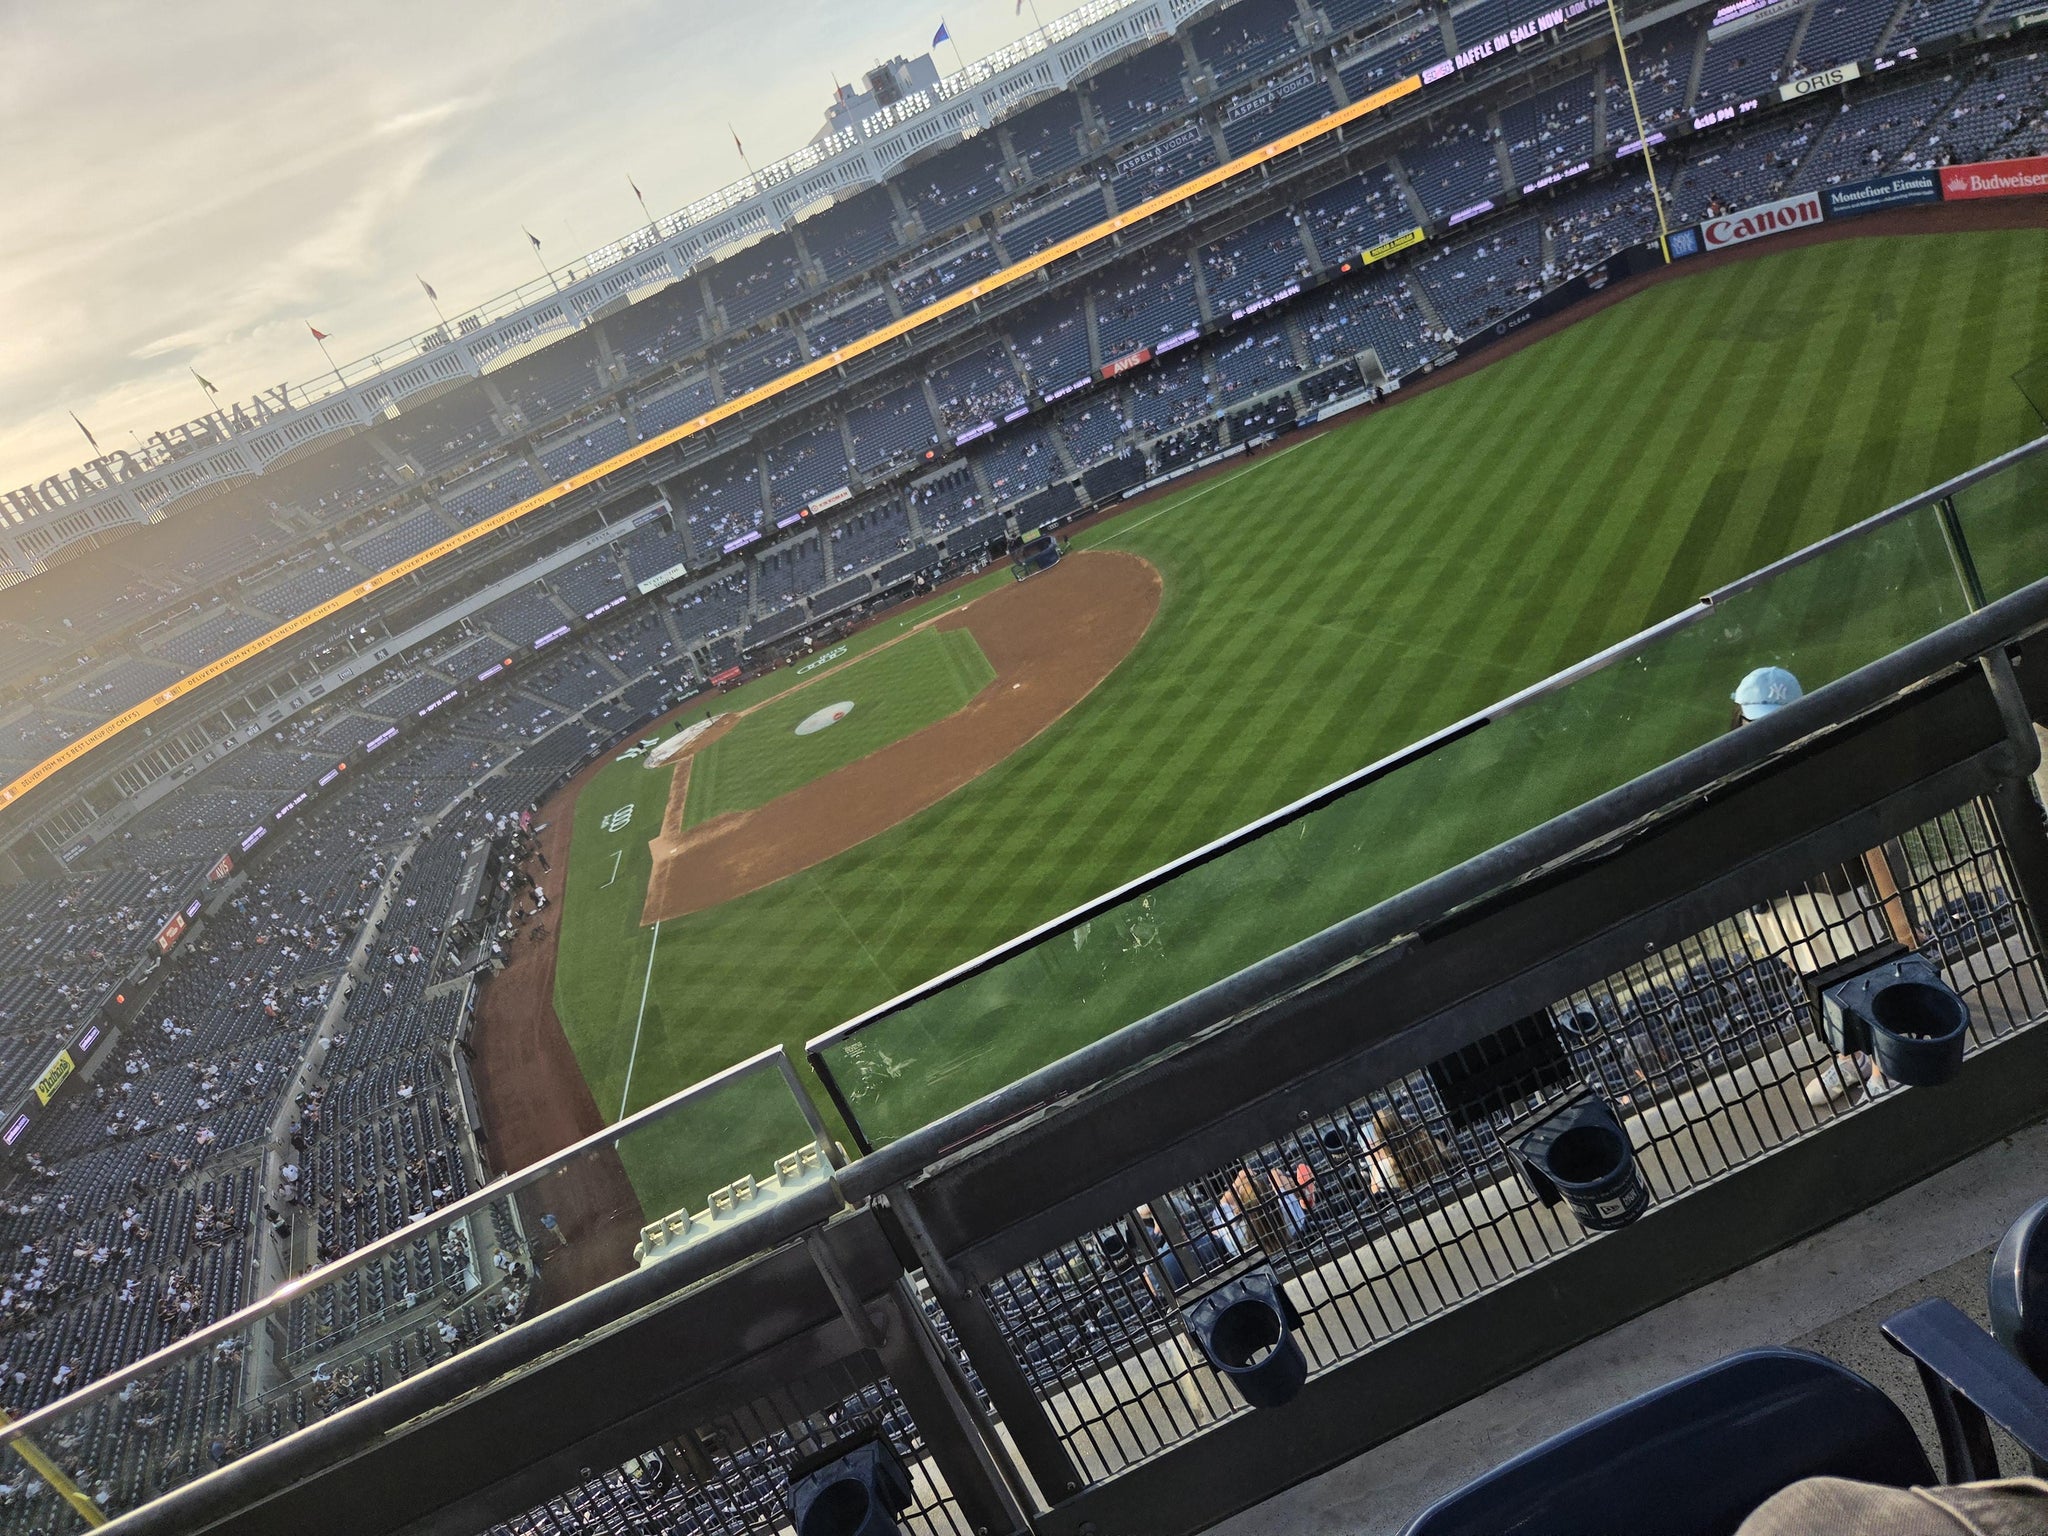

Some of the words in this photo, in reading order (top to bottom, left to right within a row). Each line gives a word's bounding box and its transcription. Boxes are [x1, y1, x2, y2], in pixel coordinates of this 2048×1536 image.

[1455, 40, 1494, 70] RAFFLE
[1493, 33, 1510, 52] ON
[1509, 20, 1538, 44] SALE
[1537, 8, 1564, 32] NOW
[1234, 97, 1266, 118] ASPEN
[1277, 76, 1309, 97] VODKA
[1795, 69, 1844, 94] ORIS
[1122, 151, 1153, 171] ASPEN
[1163, 131, 1195, 151] VODKA
[1831, 186, 1891, 205] Montefiore
[1892, 176, 1933, 193] Einstein
[1970, 172, 2048, 191] Budweiser
[1705, 200, 1820, 245] Canon
[1114, 355, 1140, 374] AVIS
[188, 665, 218, 686] DELIVERY
[220, 654, 241, 667] FROM
[257, 635, 275, 647] BEST
[275, 622, 298, 639] LINEUP
[1768, 682, 1787, 700] NY
[21, 770, 43, 788] DELIVERY
[42, 761, 56, 773] FROM
[71, 743, 87, 754] BEST
[86, 731, 106, 746] LINEUP
